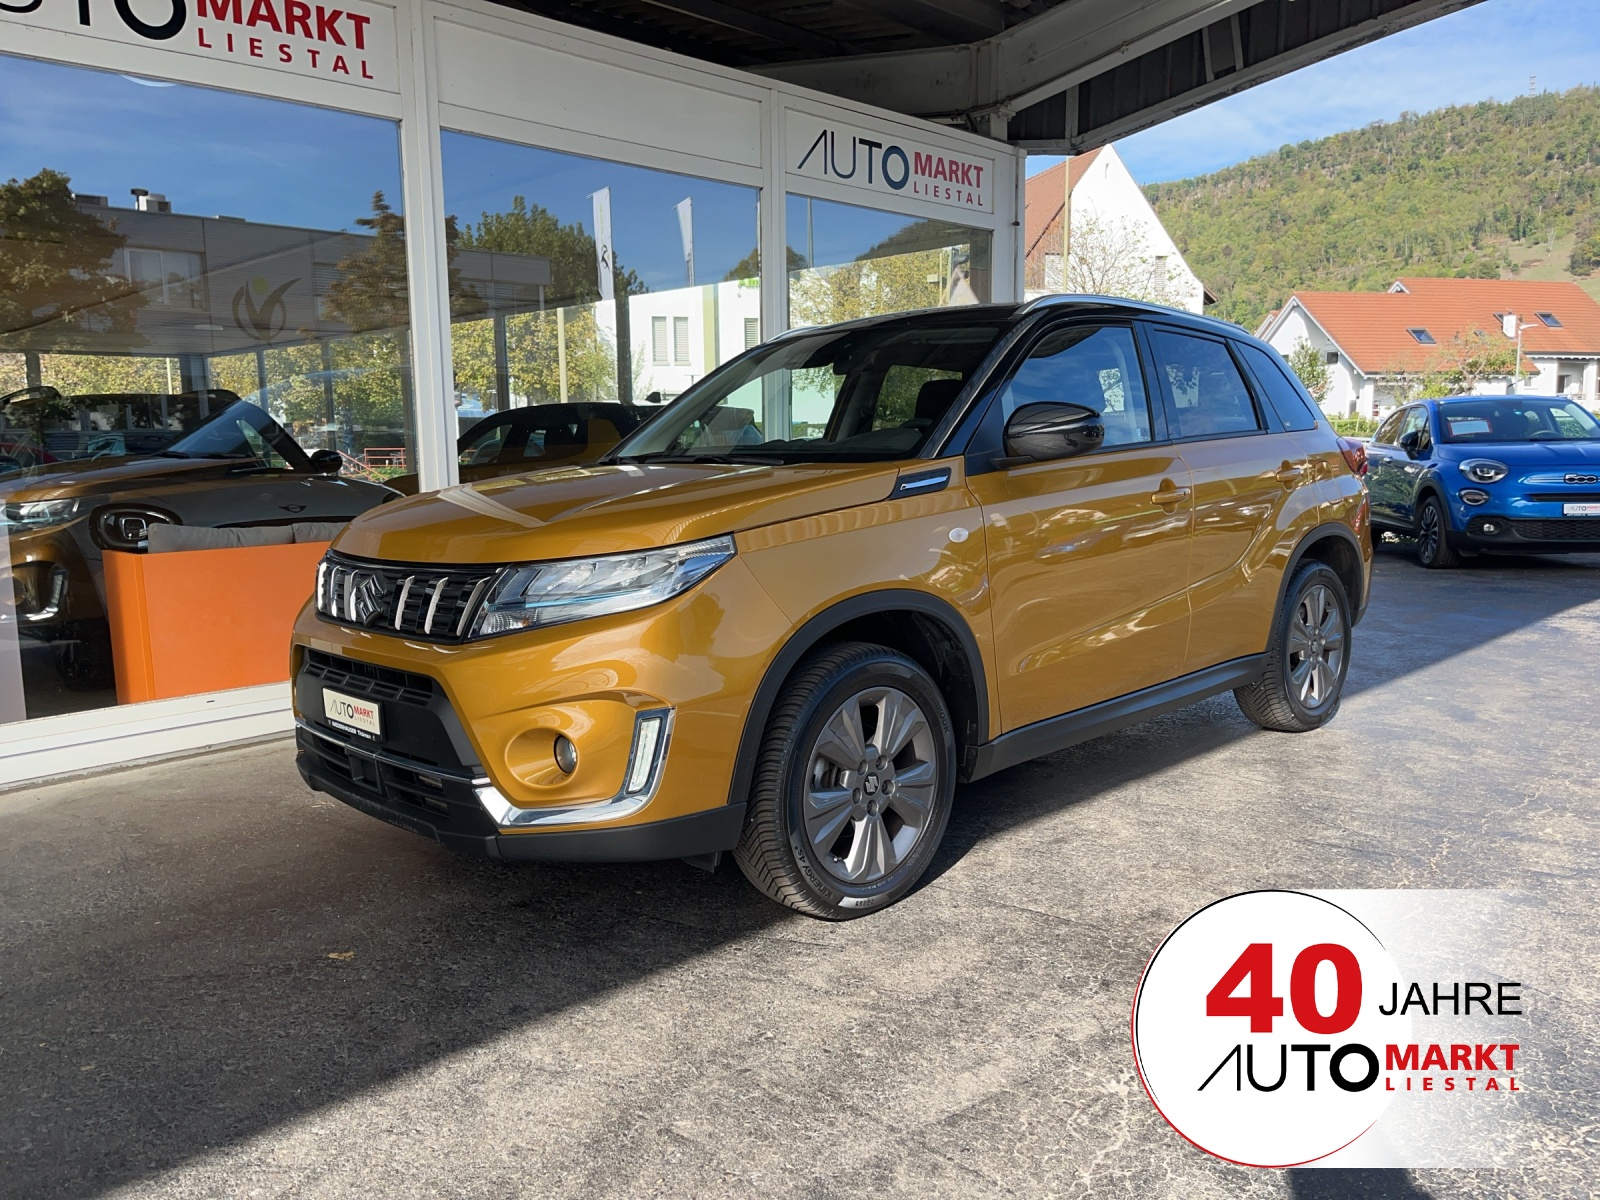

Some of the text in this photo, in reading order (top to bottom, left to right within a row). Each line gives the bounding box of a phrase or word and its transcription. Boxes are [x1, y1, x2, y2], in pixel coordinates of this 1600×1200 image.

[197, 0, 370, 50] MARKT
[198, 27, 374, 80] LIESTAL
[914, 151, 984, 188] MARKT
[914, 181, 984, 207] LIESTAL
[801, 865, 833, 899] KINERGY
